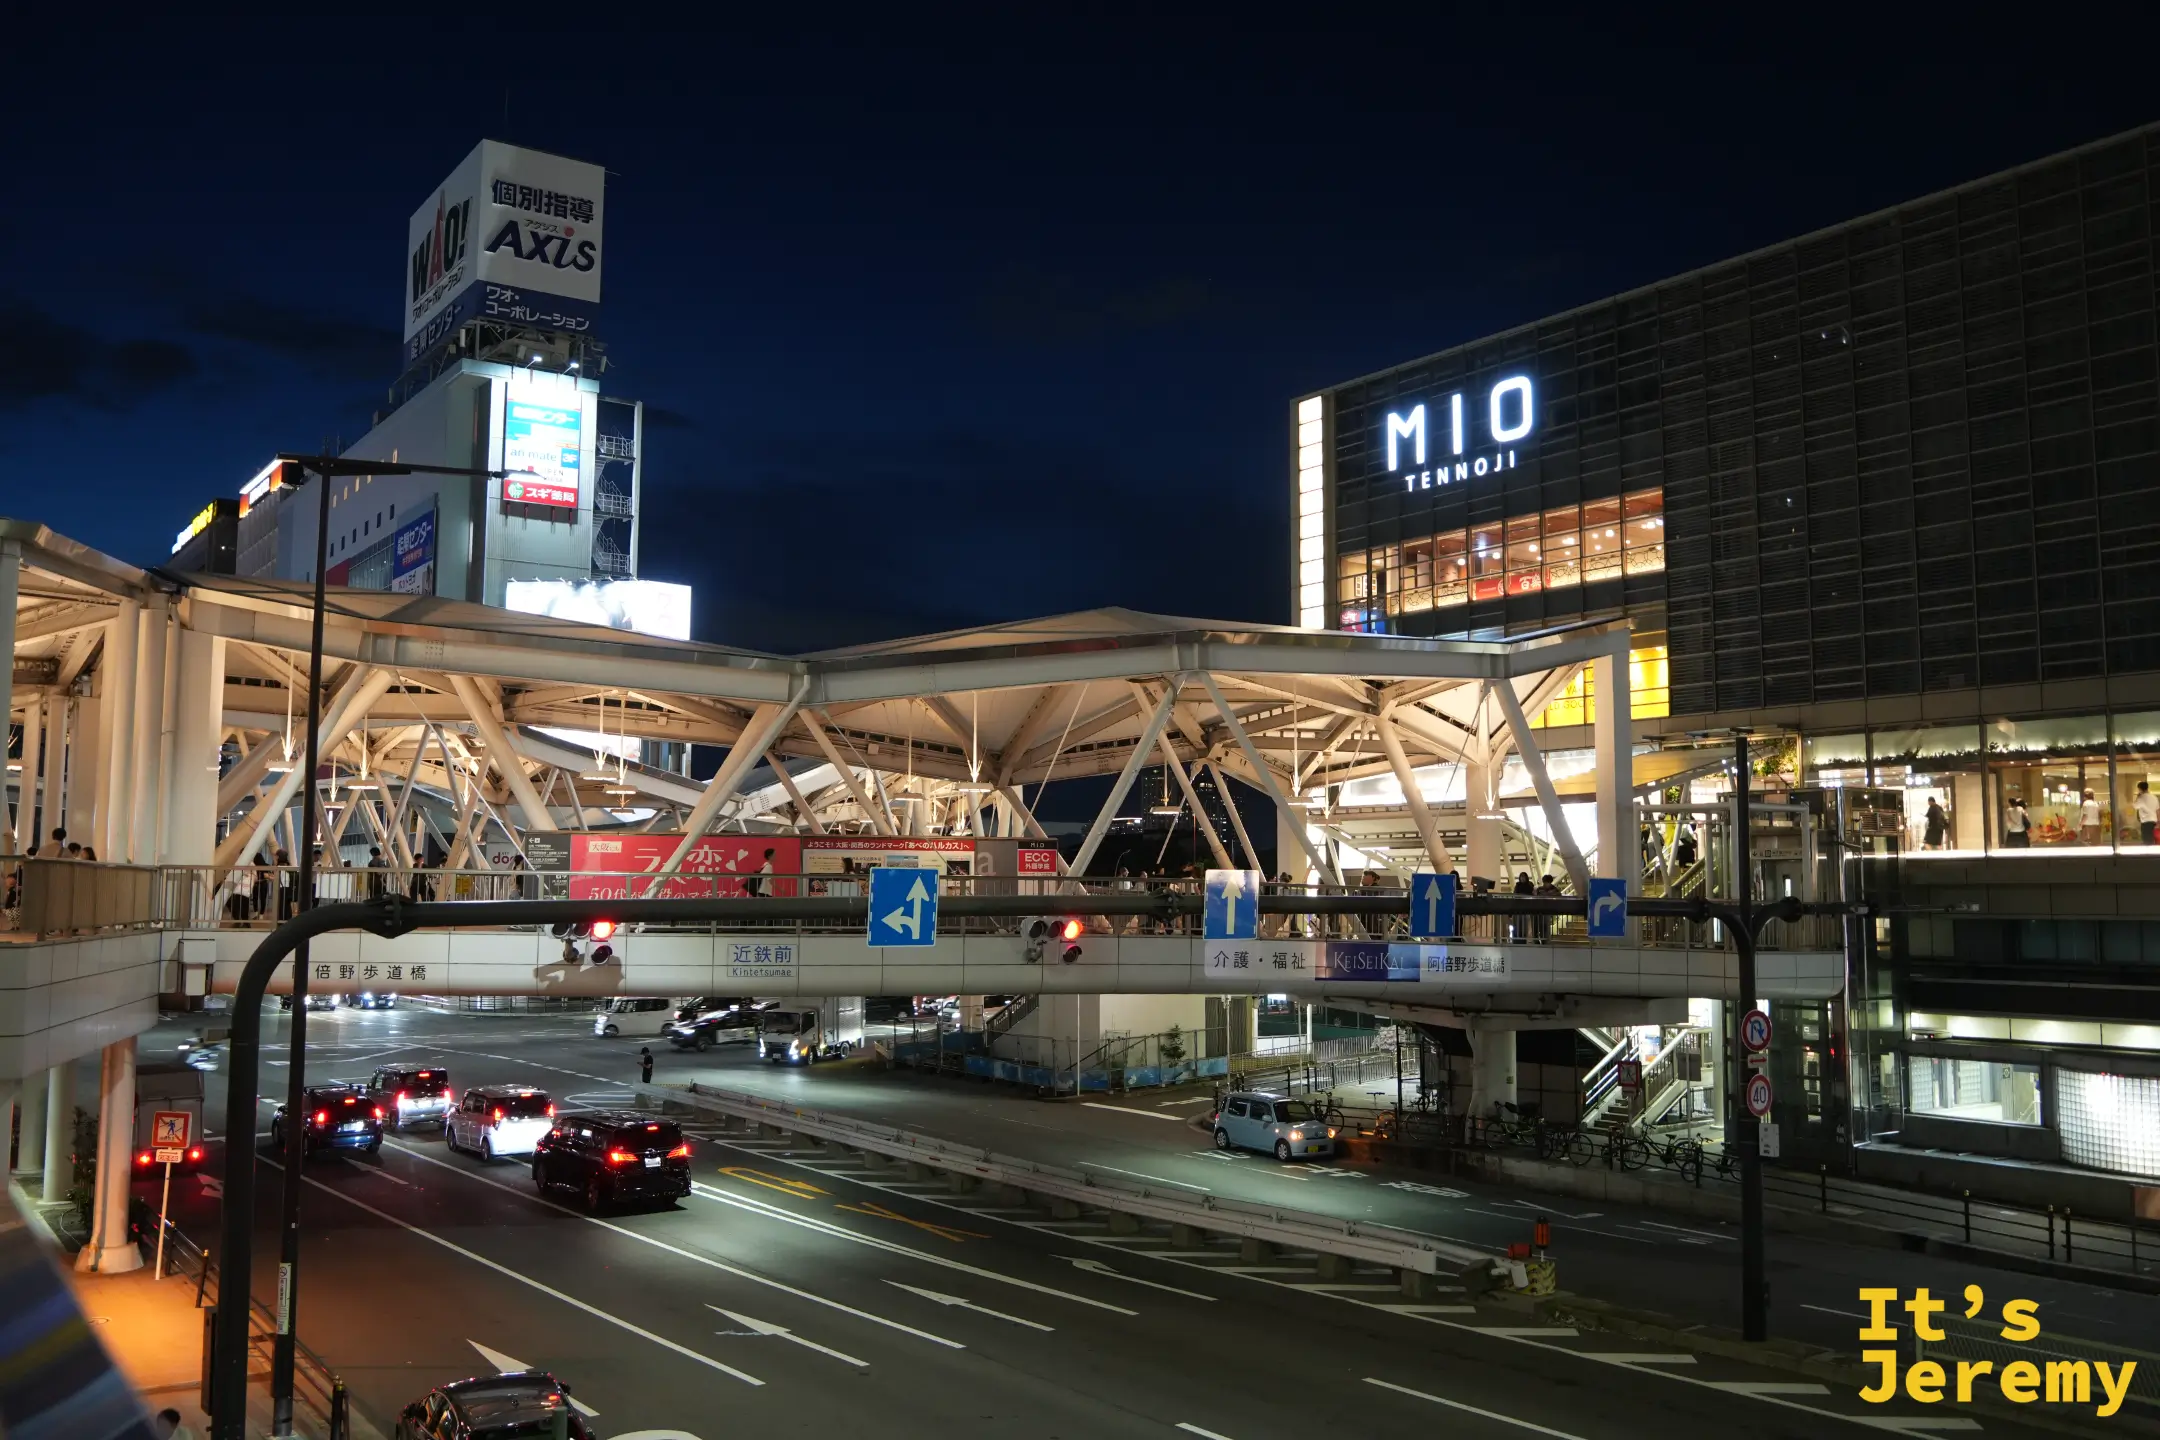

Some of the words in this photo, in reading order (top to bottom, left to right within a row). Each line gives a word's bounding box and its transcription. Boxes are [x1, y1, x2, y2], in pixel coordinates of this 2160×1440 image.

[493, 178, 594, 224] 個別指導
[524, 218, 559, 234] アクシス
[412, 188, 471, 304] WAO!
[485, 301, 590, 331] コーポレーション
[1386, 375, 1534, 472] MIO
[1405, 450, 1516, 492] TENNOJI
[525, 487, 575, 503] スギ薬局
[1024, 852, 1050, 862] ECC
[733, 944, 793, 964] 近鉄前
[1213, 950, 1307, 970] 介護・福祉
[292, 964, 427, 980] 倍野歩道橋
[732, 967, 792, 977] Kintetsumae
[1427, 955, 1505, 974] 阿倍野歩道橋
[1753, 1086, 1767, 1104] 40
